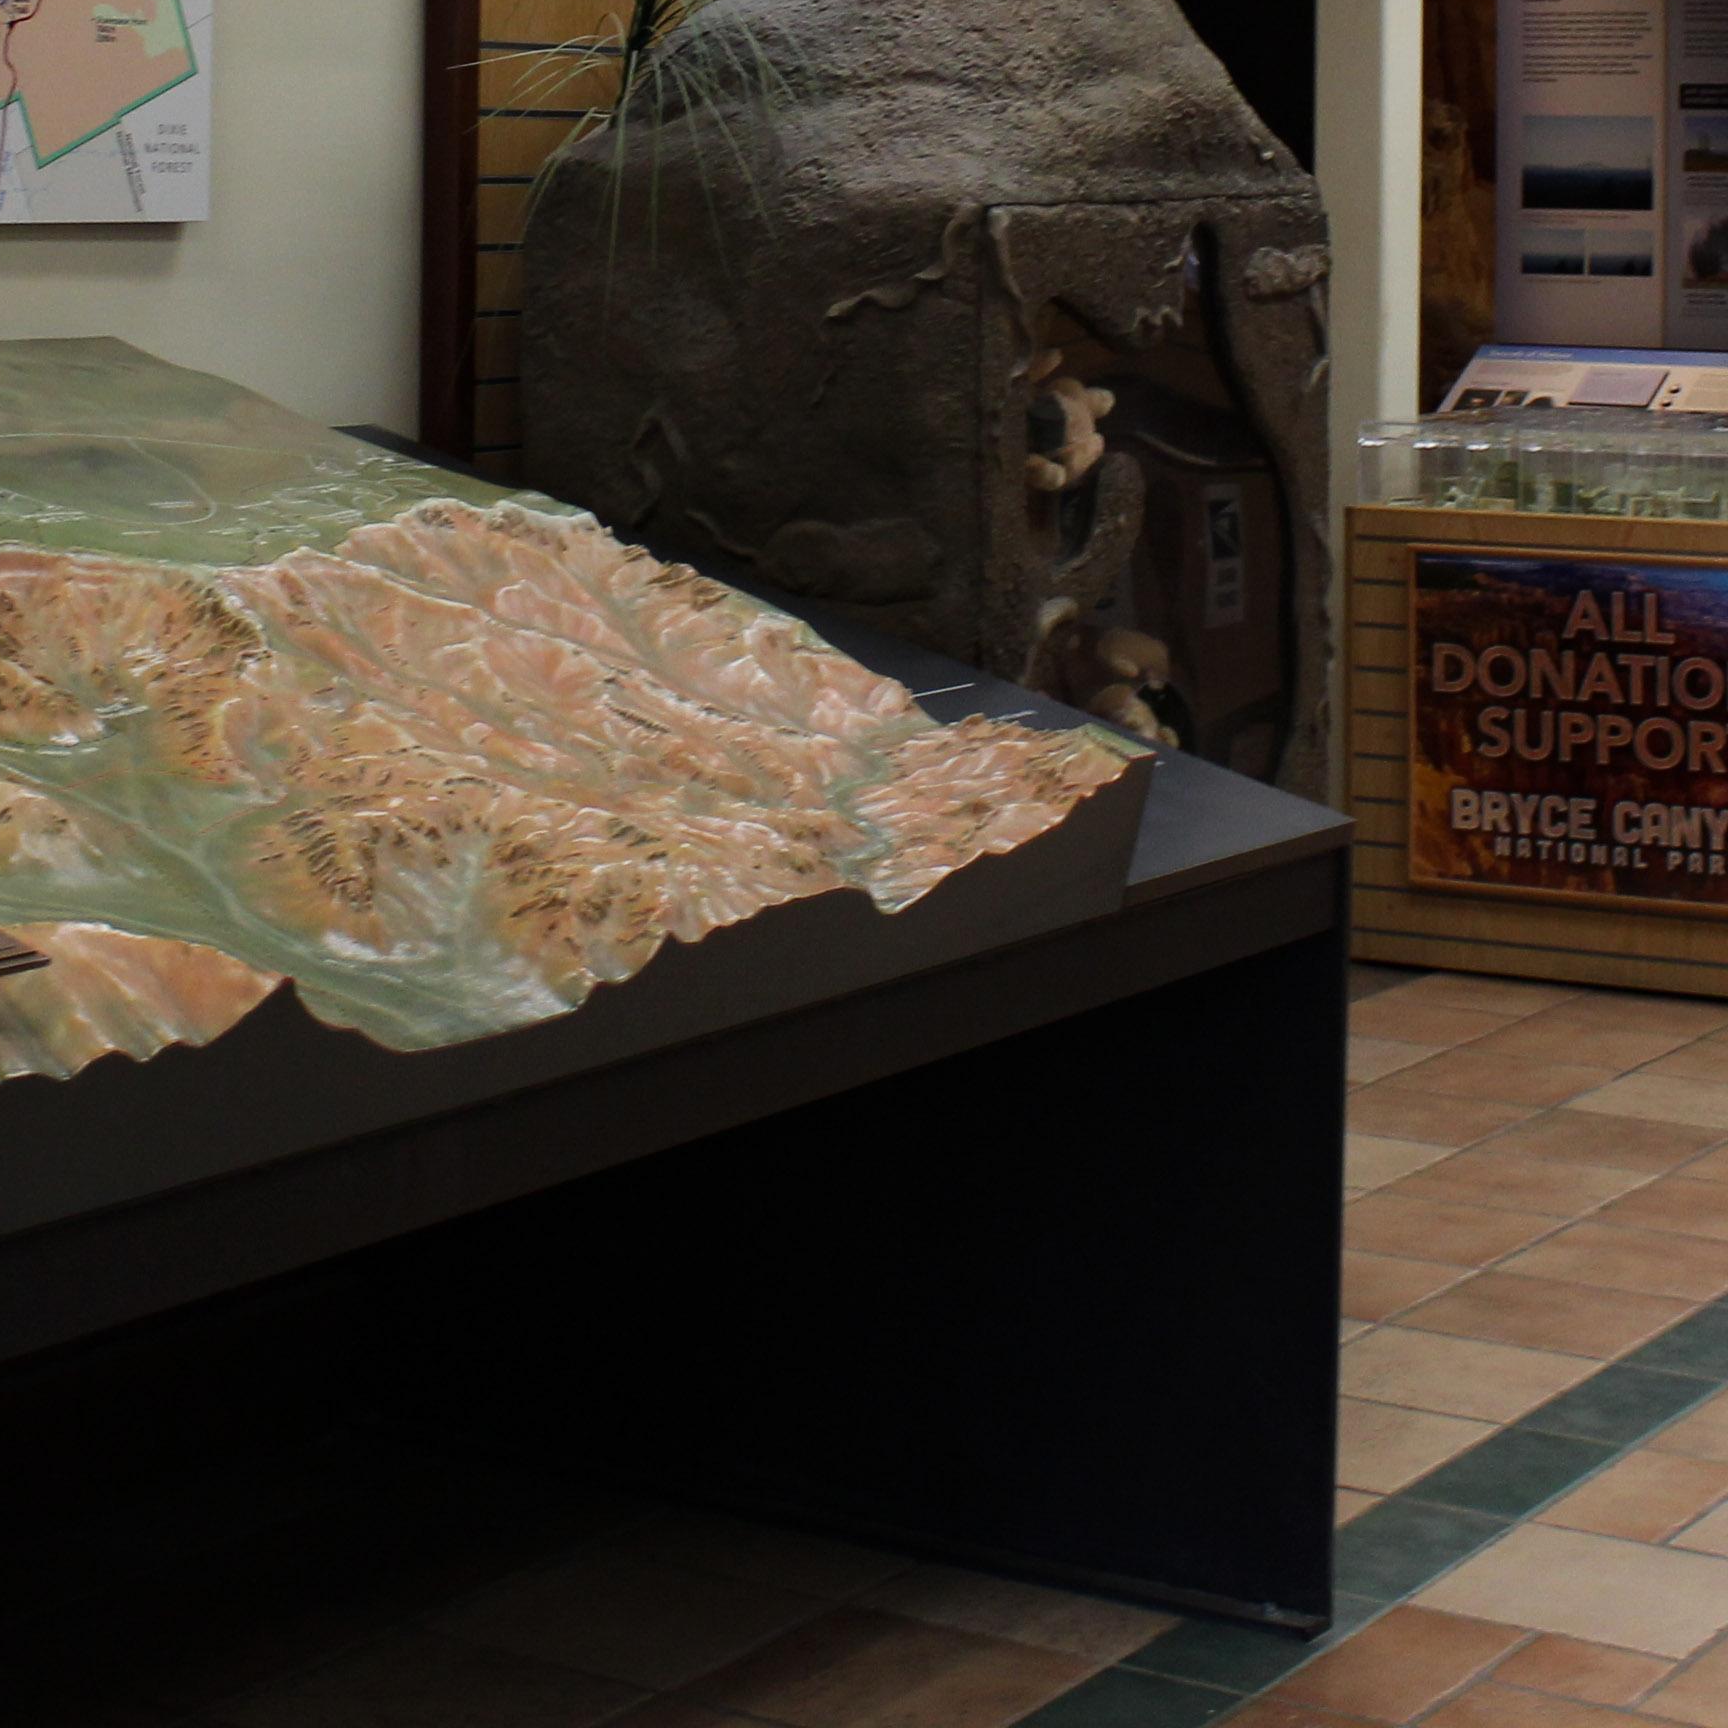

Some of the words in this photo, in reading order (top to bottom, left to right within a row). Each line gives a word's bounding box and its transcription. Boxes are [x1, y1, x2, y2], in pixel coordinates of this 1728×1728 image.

[1562, 589, 1676, 645] ALL
[1450, 788, 1598, 842] BRYCE
[1494, 836, 1649, 870] NATIONAL
